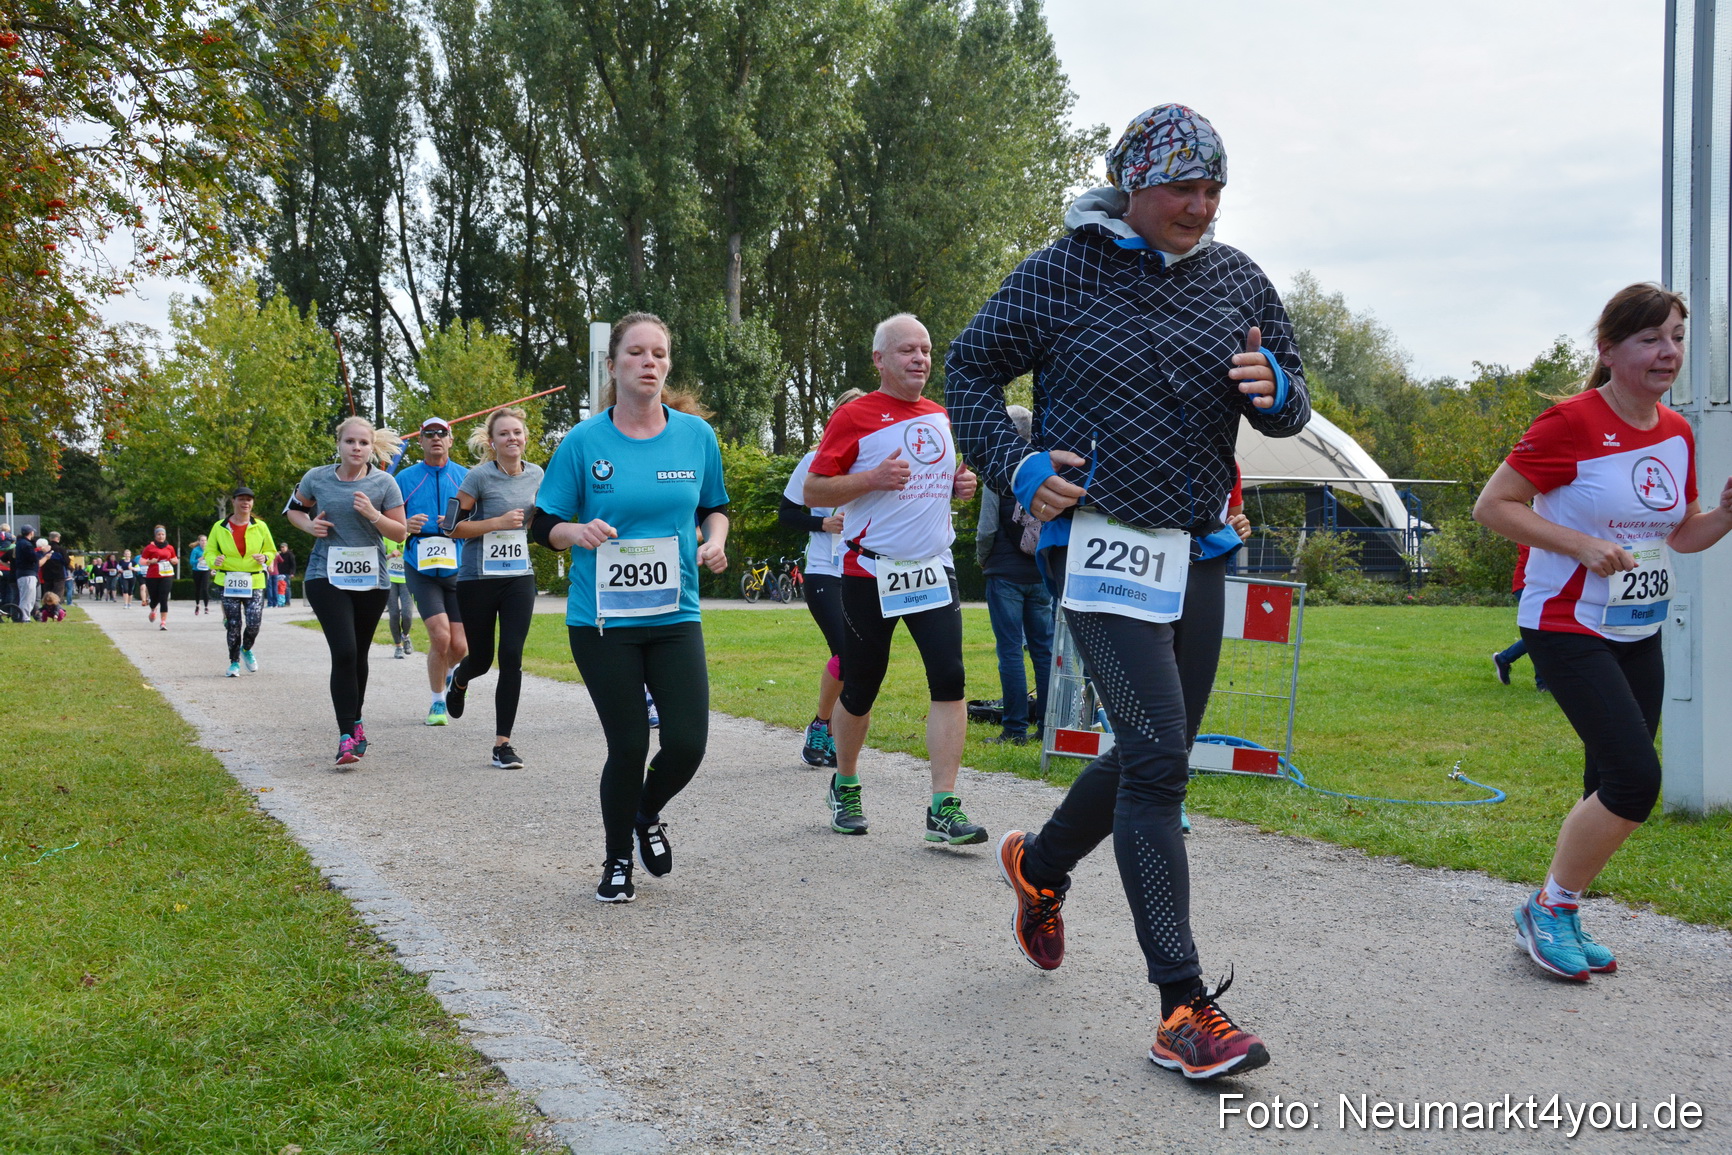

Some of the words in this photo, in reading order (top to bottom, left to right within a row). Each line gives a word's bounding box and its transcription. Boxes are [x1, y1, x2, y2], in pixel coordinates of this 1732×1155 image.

[657, 471, 696, 480] BOCK
[426, 546, 447, 557] 224
[490, 544, 522, 558] 2416
[627, 545, 655, 553] BOCK
[1084, 538, 1166, 583] 2291
[335, 561, 371, 574] 2036
[609, 561, 668, 587] 2930
[228, 580, 249, 588] 2189
[887, 567, 937, 592] 2170
[1621, 569, 1669, 600] 2338
[1097, 582, 1149, 602] Andreas
[903, 594, 928, 604] Jürgen
